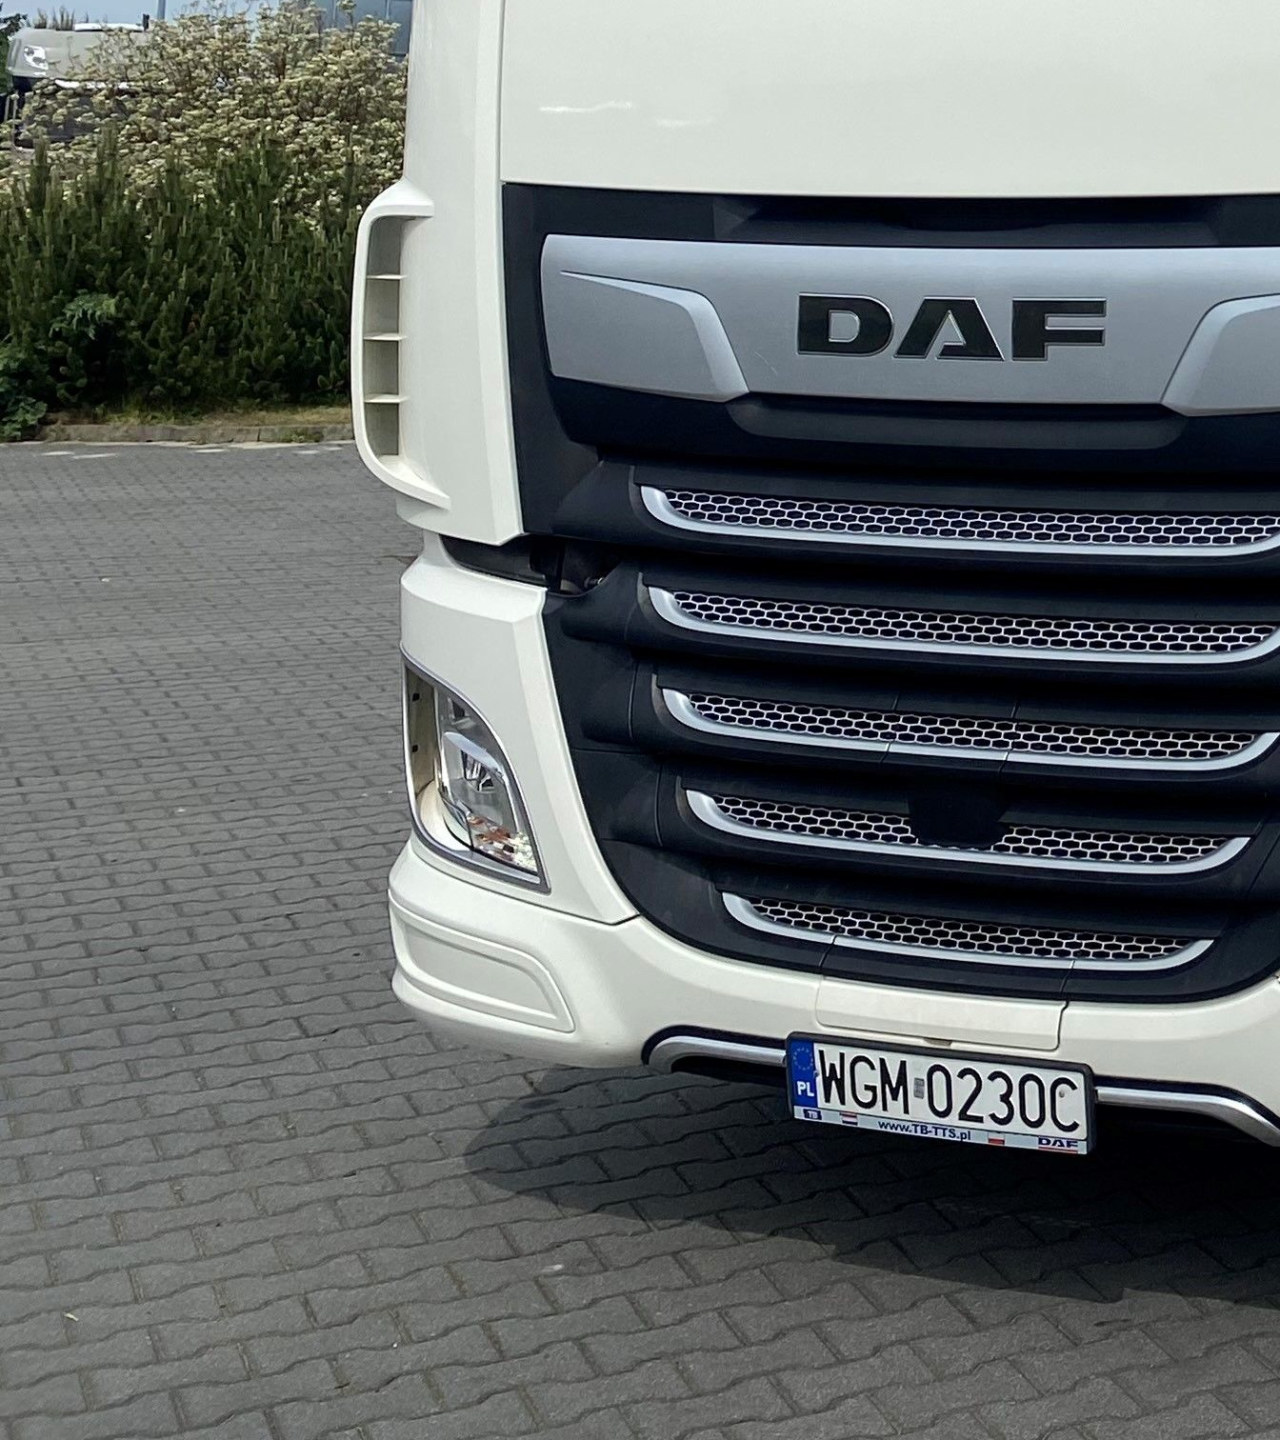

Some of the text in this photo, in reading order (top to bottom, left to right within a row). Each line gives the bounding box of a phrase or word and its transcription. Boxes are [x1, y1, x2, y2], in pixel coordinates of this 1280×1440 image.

[797, 292, 1107, 361] DAF
[796, 1081, 814, 1098] PL
[818, 1049, 1080, 1132] WGM 0230C
[877, 1120, 971, 1142] www.TB-TTS.pl
[1037, 1136, 1079, 1149] DAF
